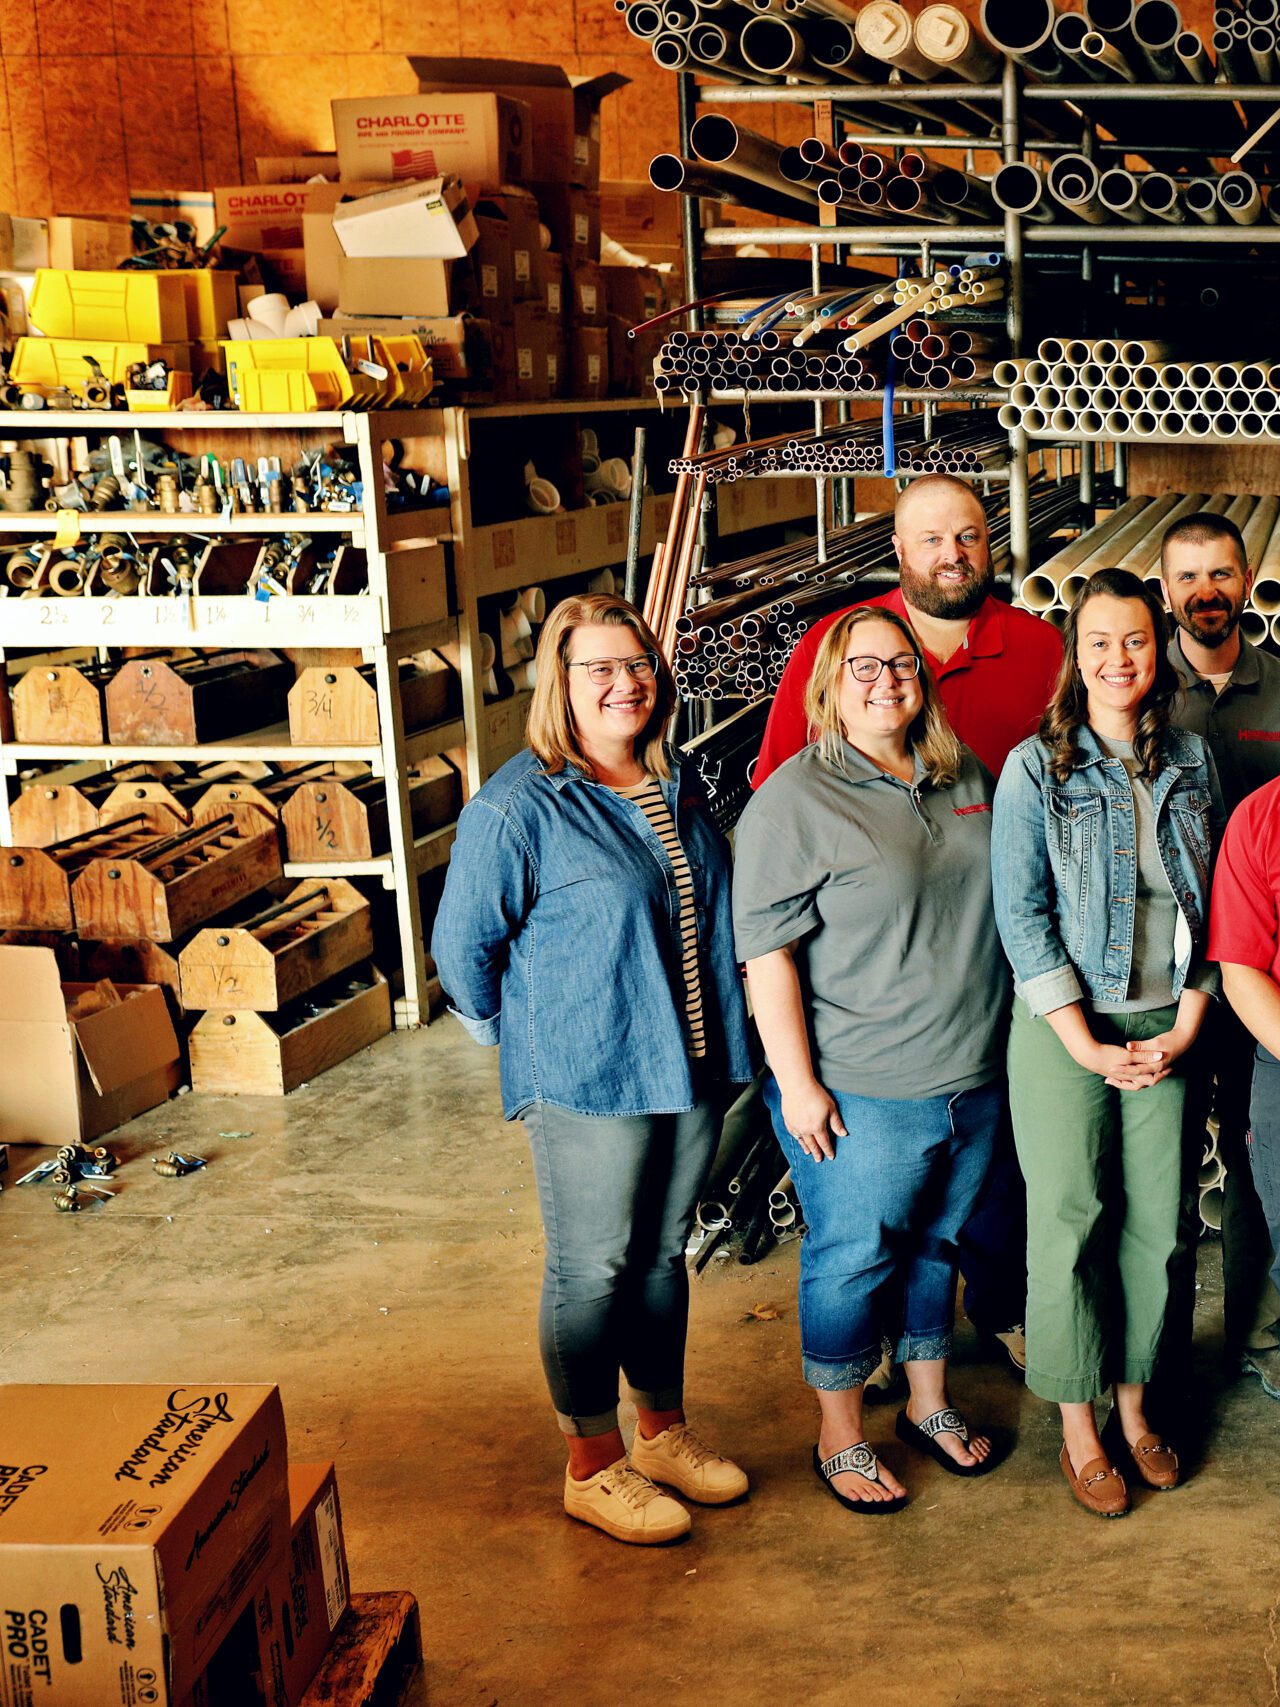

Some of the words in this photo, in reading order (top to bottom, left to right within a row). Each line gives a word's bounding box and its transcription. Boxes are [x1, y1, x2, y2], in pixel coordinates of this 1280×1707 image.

[356, 112, 465, 128] CHARLOTTE
[228, 192, 308, 207] CHARLOT
[102, 605, 116, 625] 2
[115, 1389, 210, 1481] Standard
[149, 1392, 234, 1488] American
[95, 1562, 122, 1644] Standard
[5, 1610, 29, 1659] PRO
[28, 1610, 51, 1681] CADET
